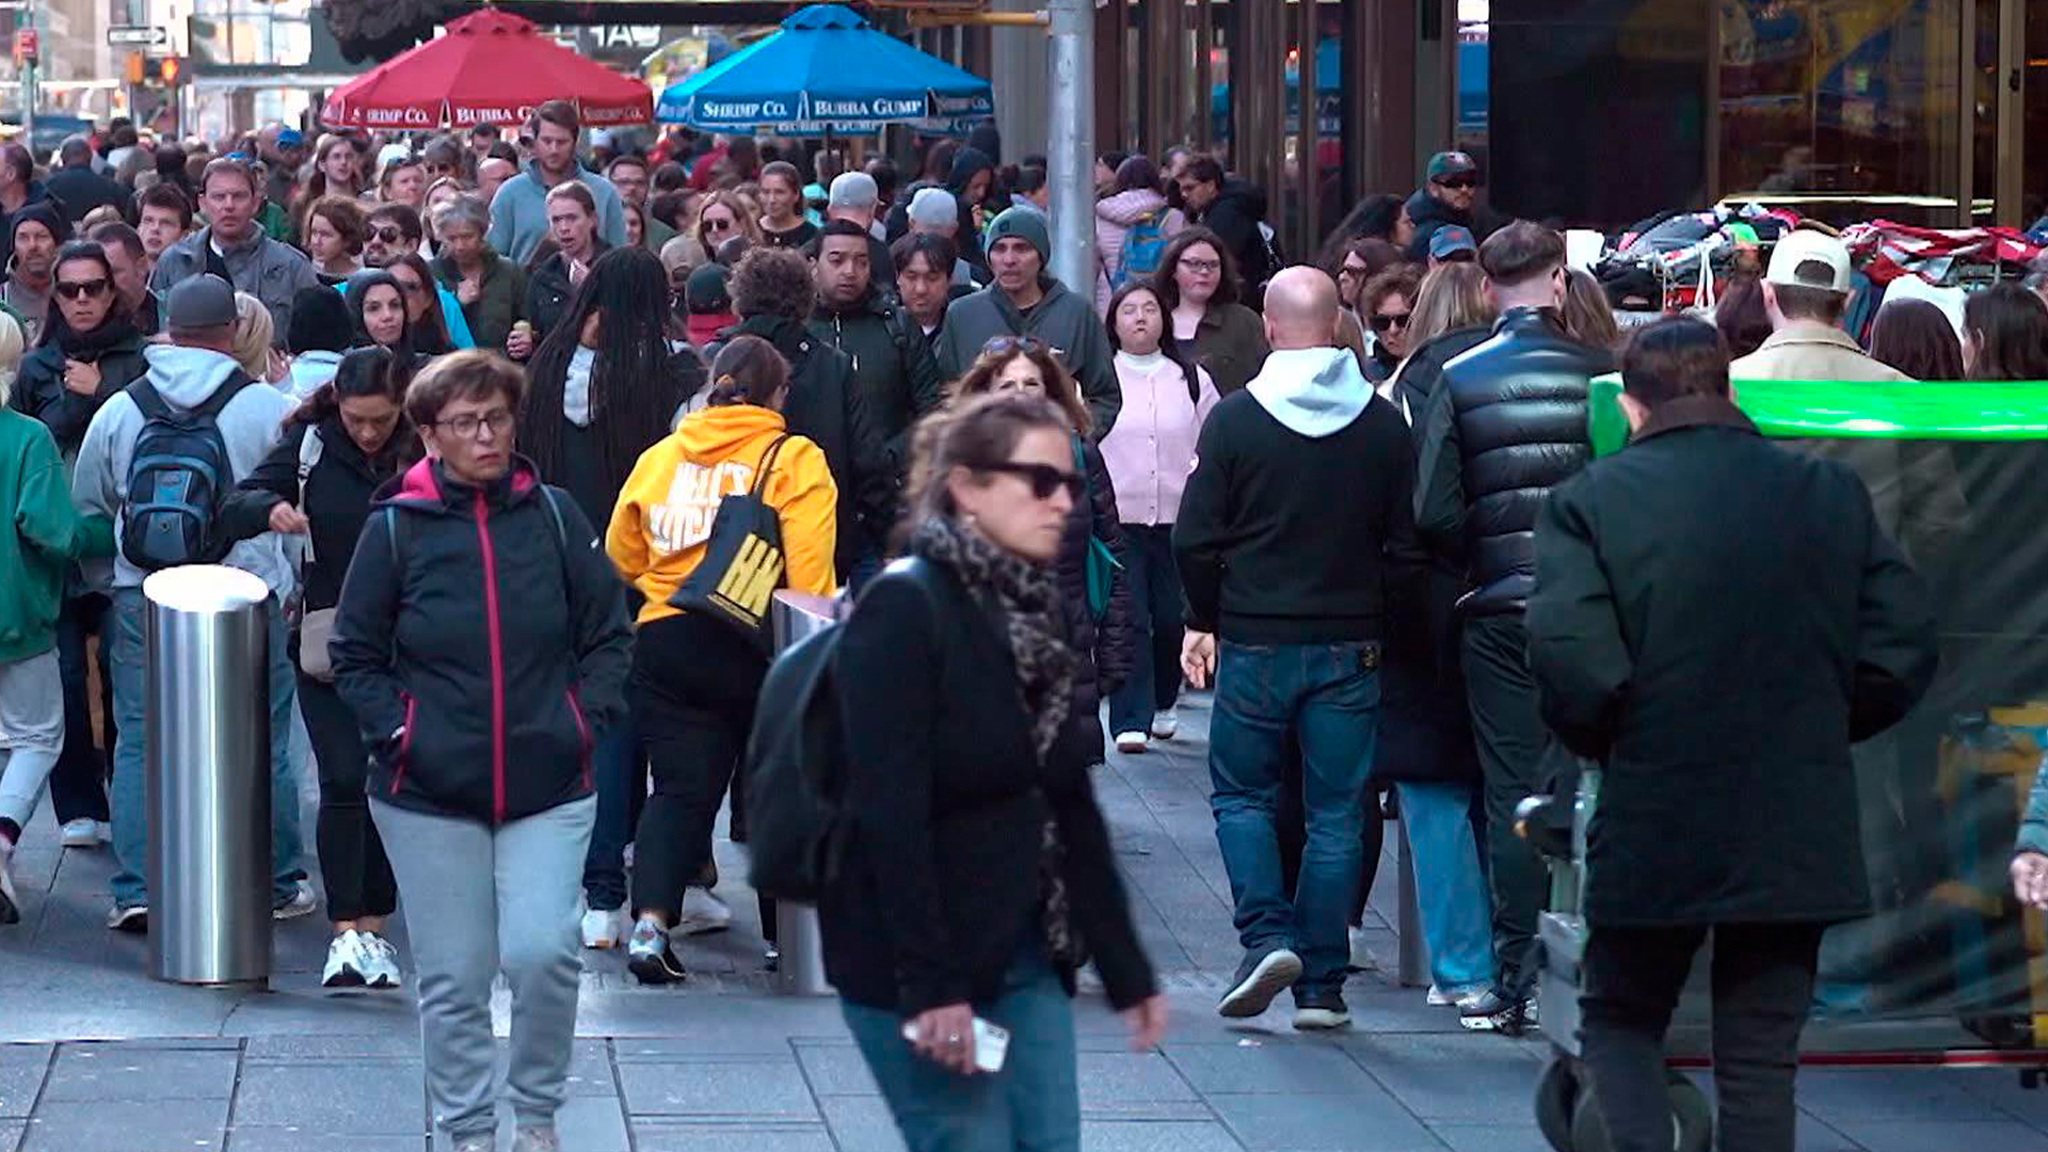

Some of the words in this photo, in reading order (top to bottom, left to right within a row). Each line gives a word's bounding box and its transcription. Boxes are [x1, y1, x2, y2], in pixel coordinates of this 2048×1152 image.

[702, 101, 760, 118] SHRIMP
[815, 100, 870, 116] BUBBA
[872, 98, 922, 115] GUMP
